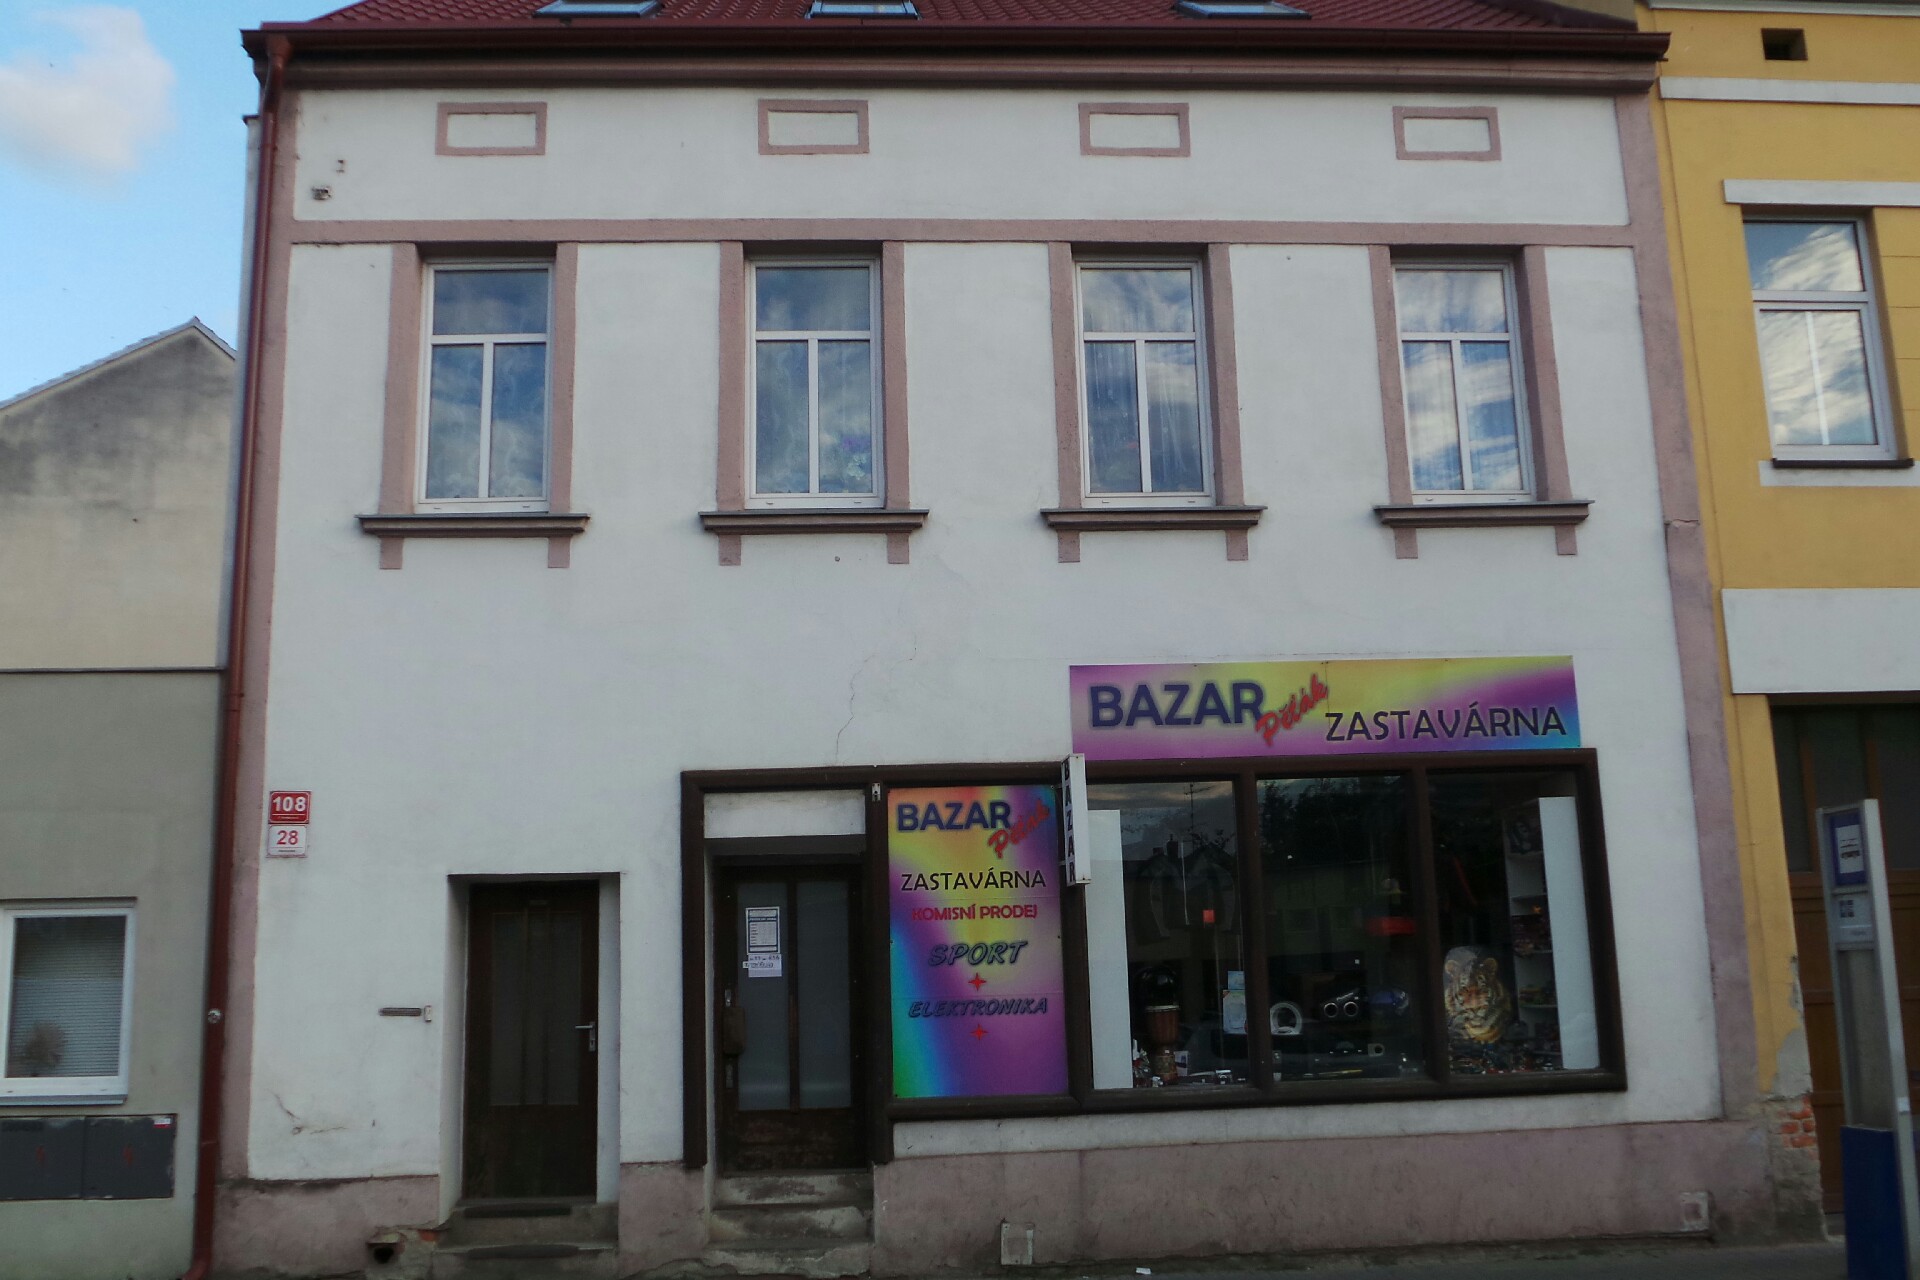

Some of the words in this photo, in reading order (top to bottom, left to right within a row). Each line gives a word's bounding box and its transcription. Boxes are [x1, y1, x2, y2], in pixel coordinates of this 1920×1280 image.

[1090, 682, 1264, 728] BAZAR
[1325, 701, 1567, 742] ZASTAVÁRNA
[273, 796, 306, 812] 108
[897, 801, 1011, 831] BAZAR
[1064, 758, 1076, 883] BAZAR
[277, 830, 299, 845] 28
[901, 867, 1047, 891] ZASTAVÁRNA
[911, 904, 976, 921] KOMISNÍ
[980, 904, 1038, 919] PRODEJ
[928, 941, 1028, 966] SPORT
[908, 998, 1048, 1018] ELEKTRONIKA
